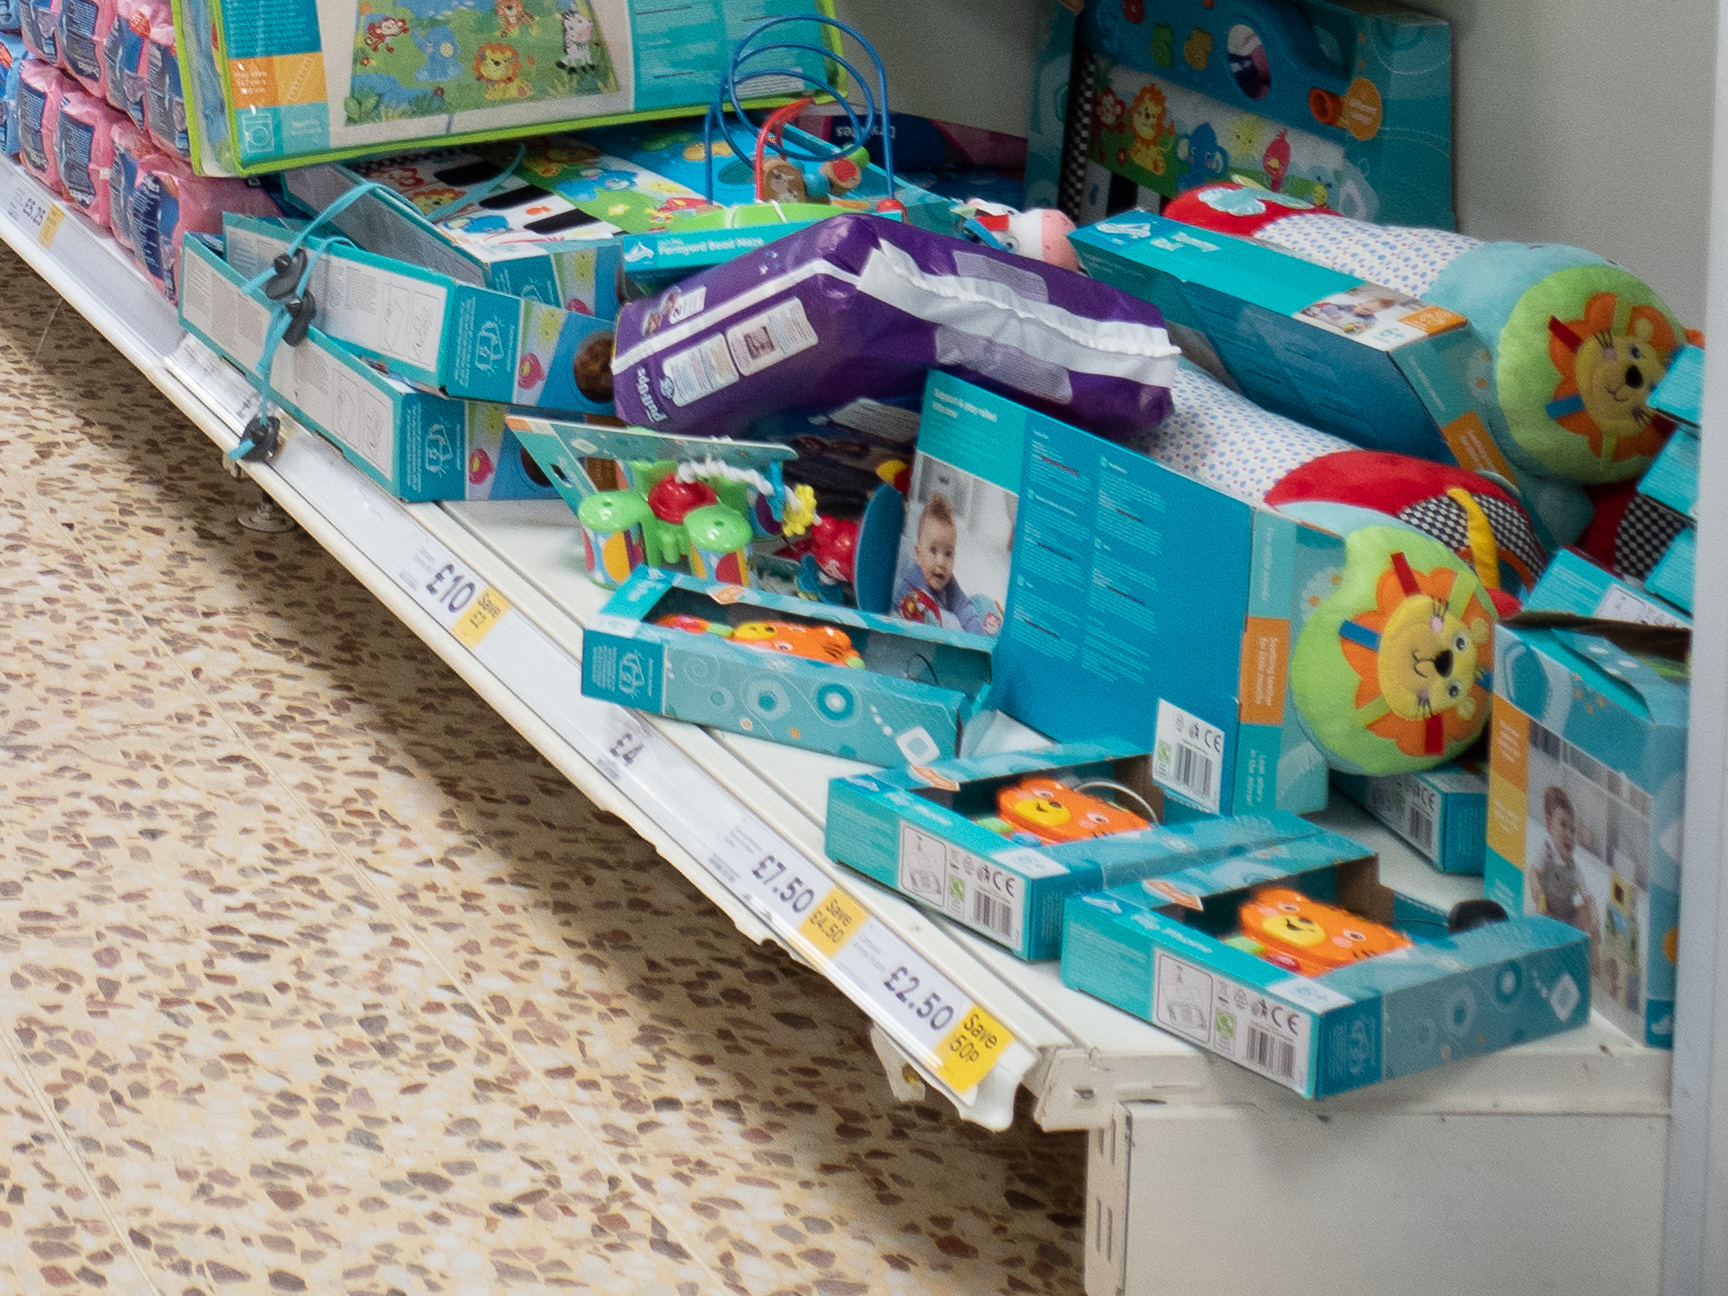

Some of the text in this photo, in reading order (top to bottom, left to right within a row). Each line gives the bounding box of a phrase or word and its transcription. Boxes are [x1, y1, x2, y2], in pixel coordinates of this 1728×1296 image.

[426, 564, 475, 614] £10
[476, 587, 502, 620] Save
[469, 608, 488, 629] £2
[610, 730, 644, 768] £4
[752, 854, 815, 914] £7.50
[809, 908, 846, 947] £4.50
[823, 897, 853, 929] Save
[883, 965, 954, 1032] £2.50
[950, 1033, 981, 1064] 50p
[963, 1012, 998, 1049] Save
